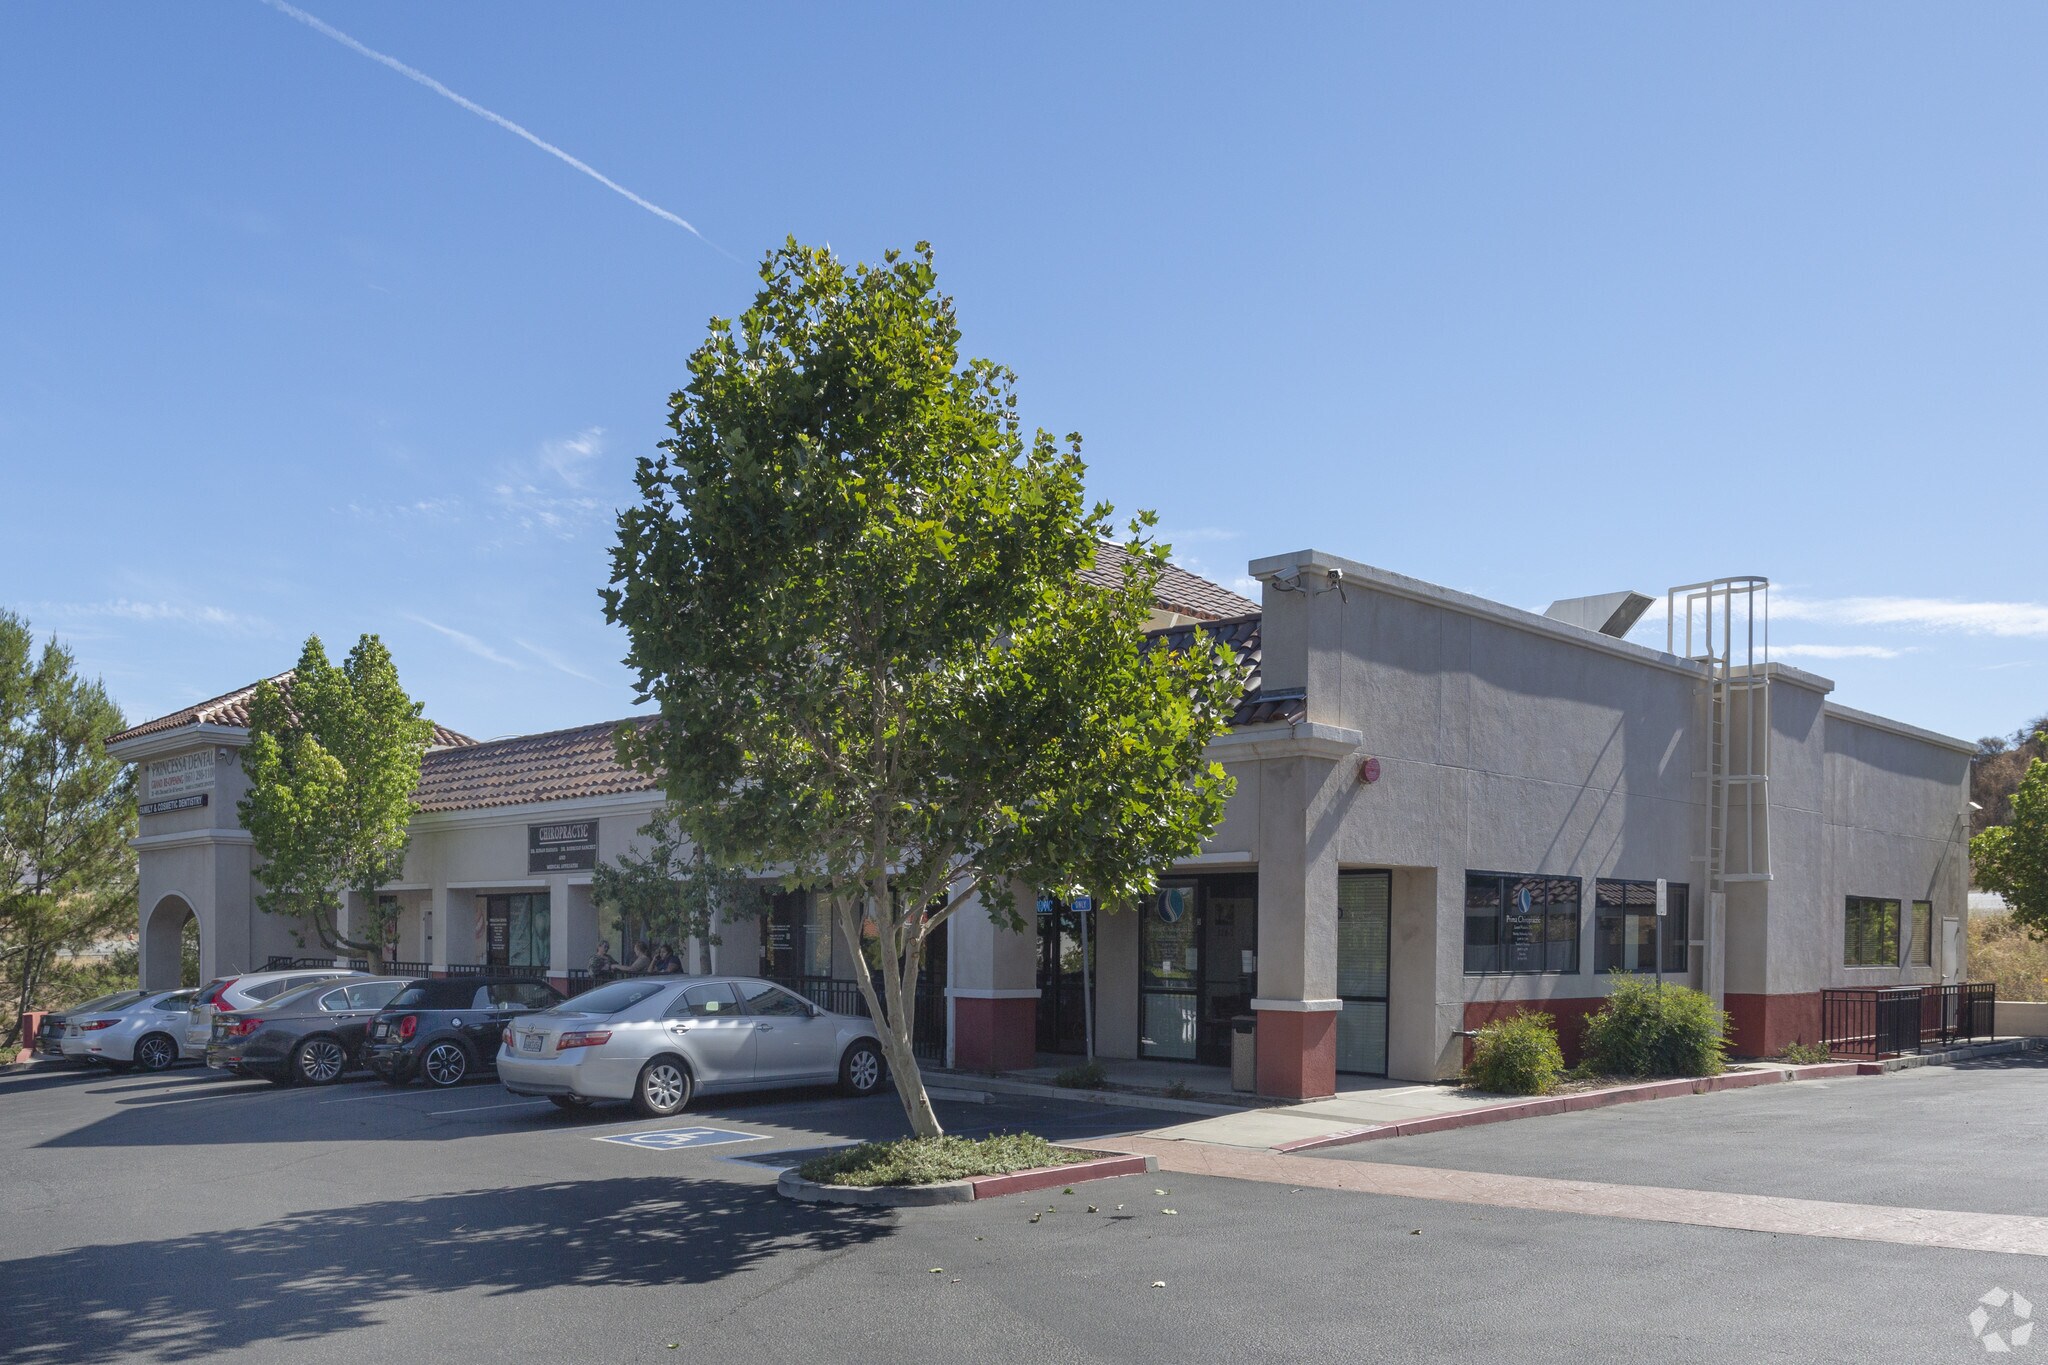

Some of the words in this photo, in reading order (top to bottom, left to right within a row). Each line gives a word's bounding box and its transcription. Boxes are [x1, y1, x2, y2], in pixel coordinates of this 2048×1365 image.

[188, 750, 215, 770] DENTAL
[140, 804, 153, 814] FAMILY
[153, 803, 158, 812] &
[157, 800, 178, 812] COSMETIC
[179, 796, 203, 808] DENTISTRY
[540, 824, 588, 840] CHIROPRACTIC
